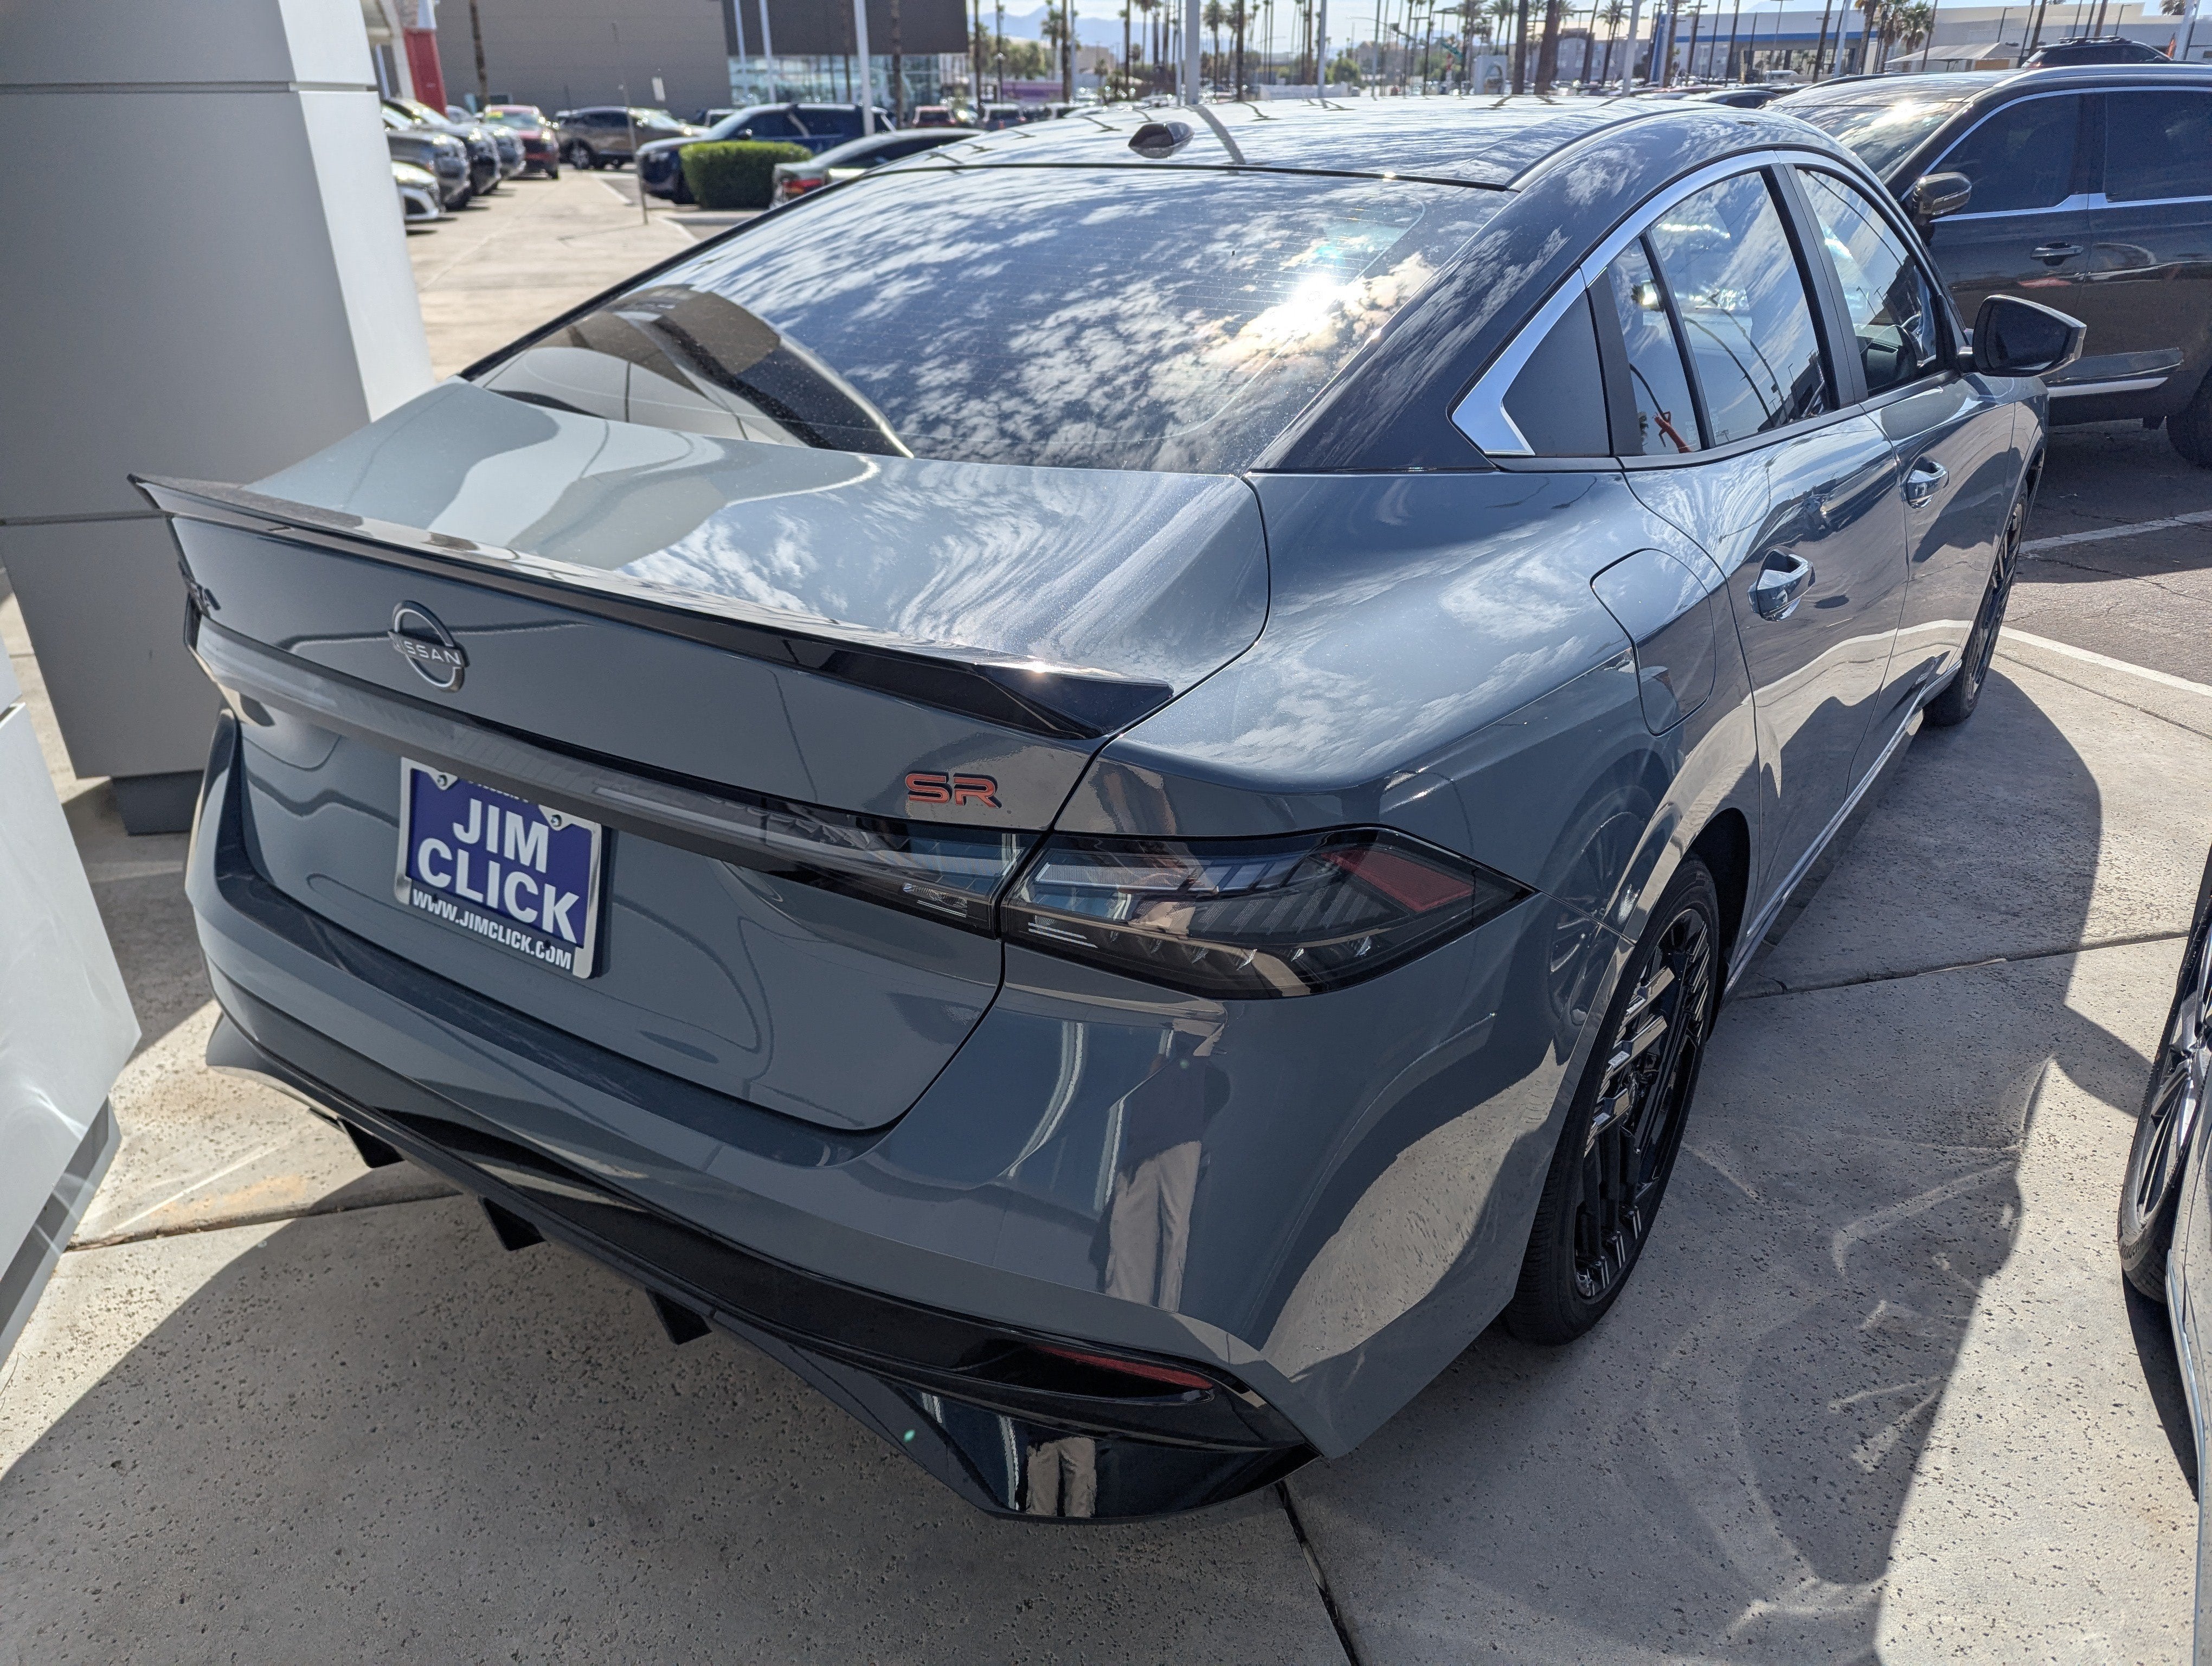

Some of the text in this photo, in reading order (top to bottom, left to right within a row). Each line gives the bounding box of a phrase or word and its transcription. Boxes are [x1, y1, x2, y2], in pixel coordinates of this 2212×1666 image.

[905, 772, 1001, 809] SR
[453, 798, 549, 874] JIM
[417, 838, 580, 944] CLICK
